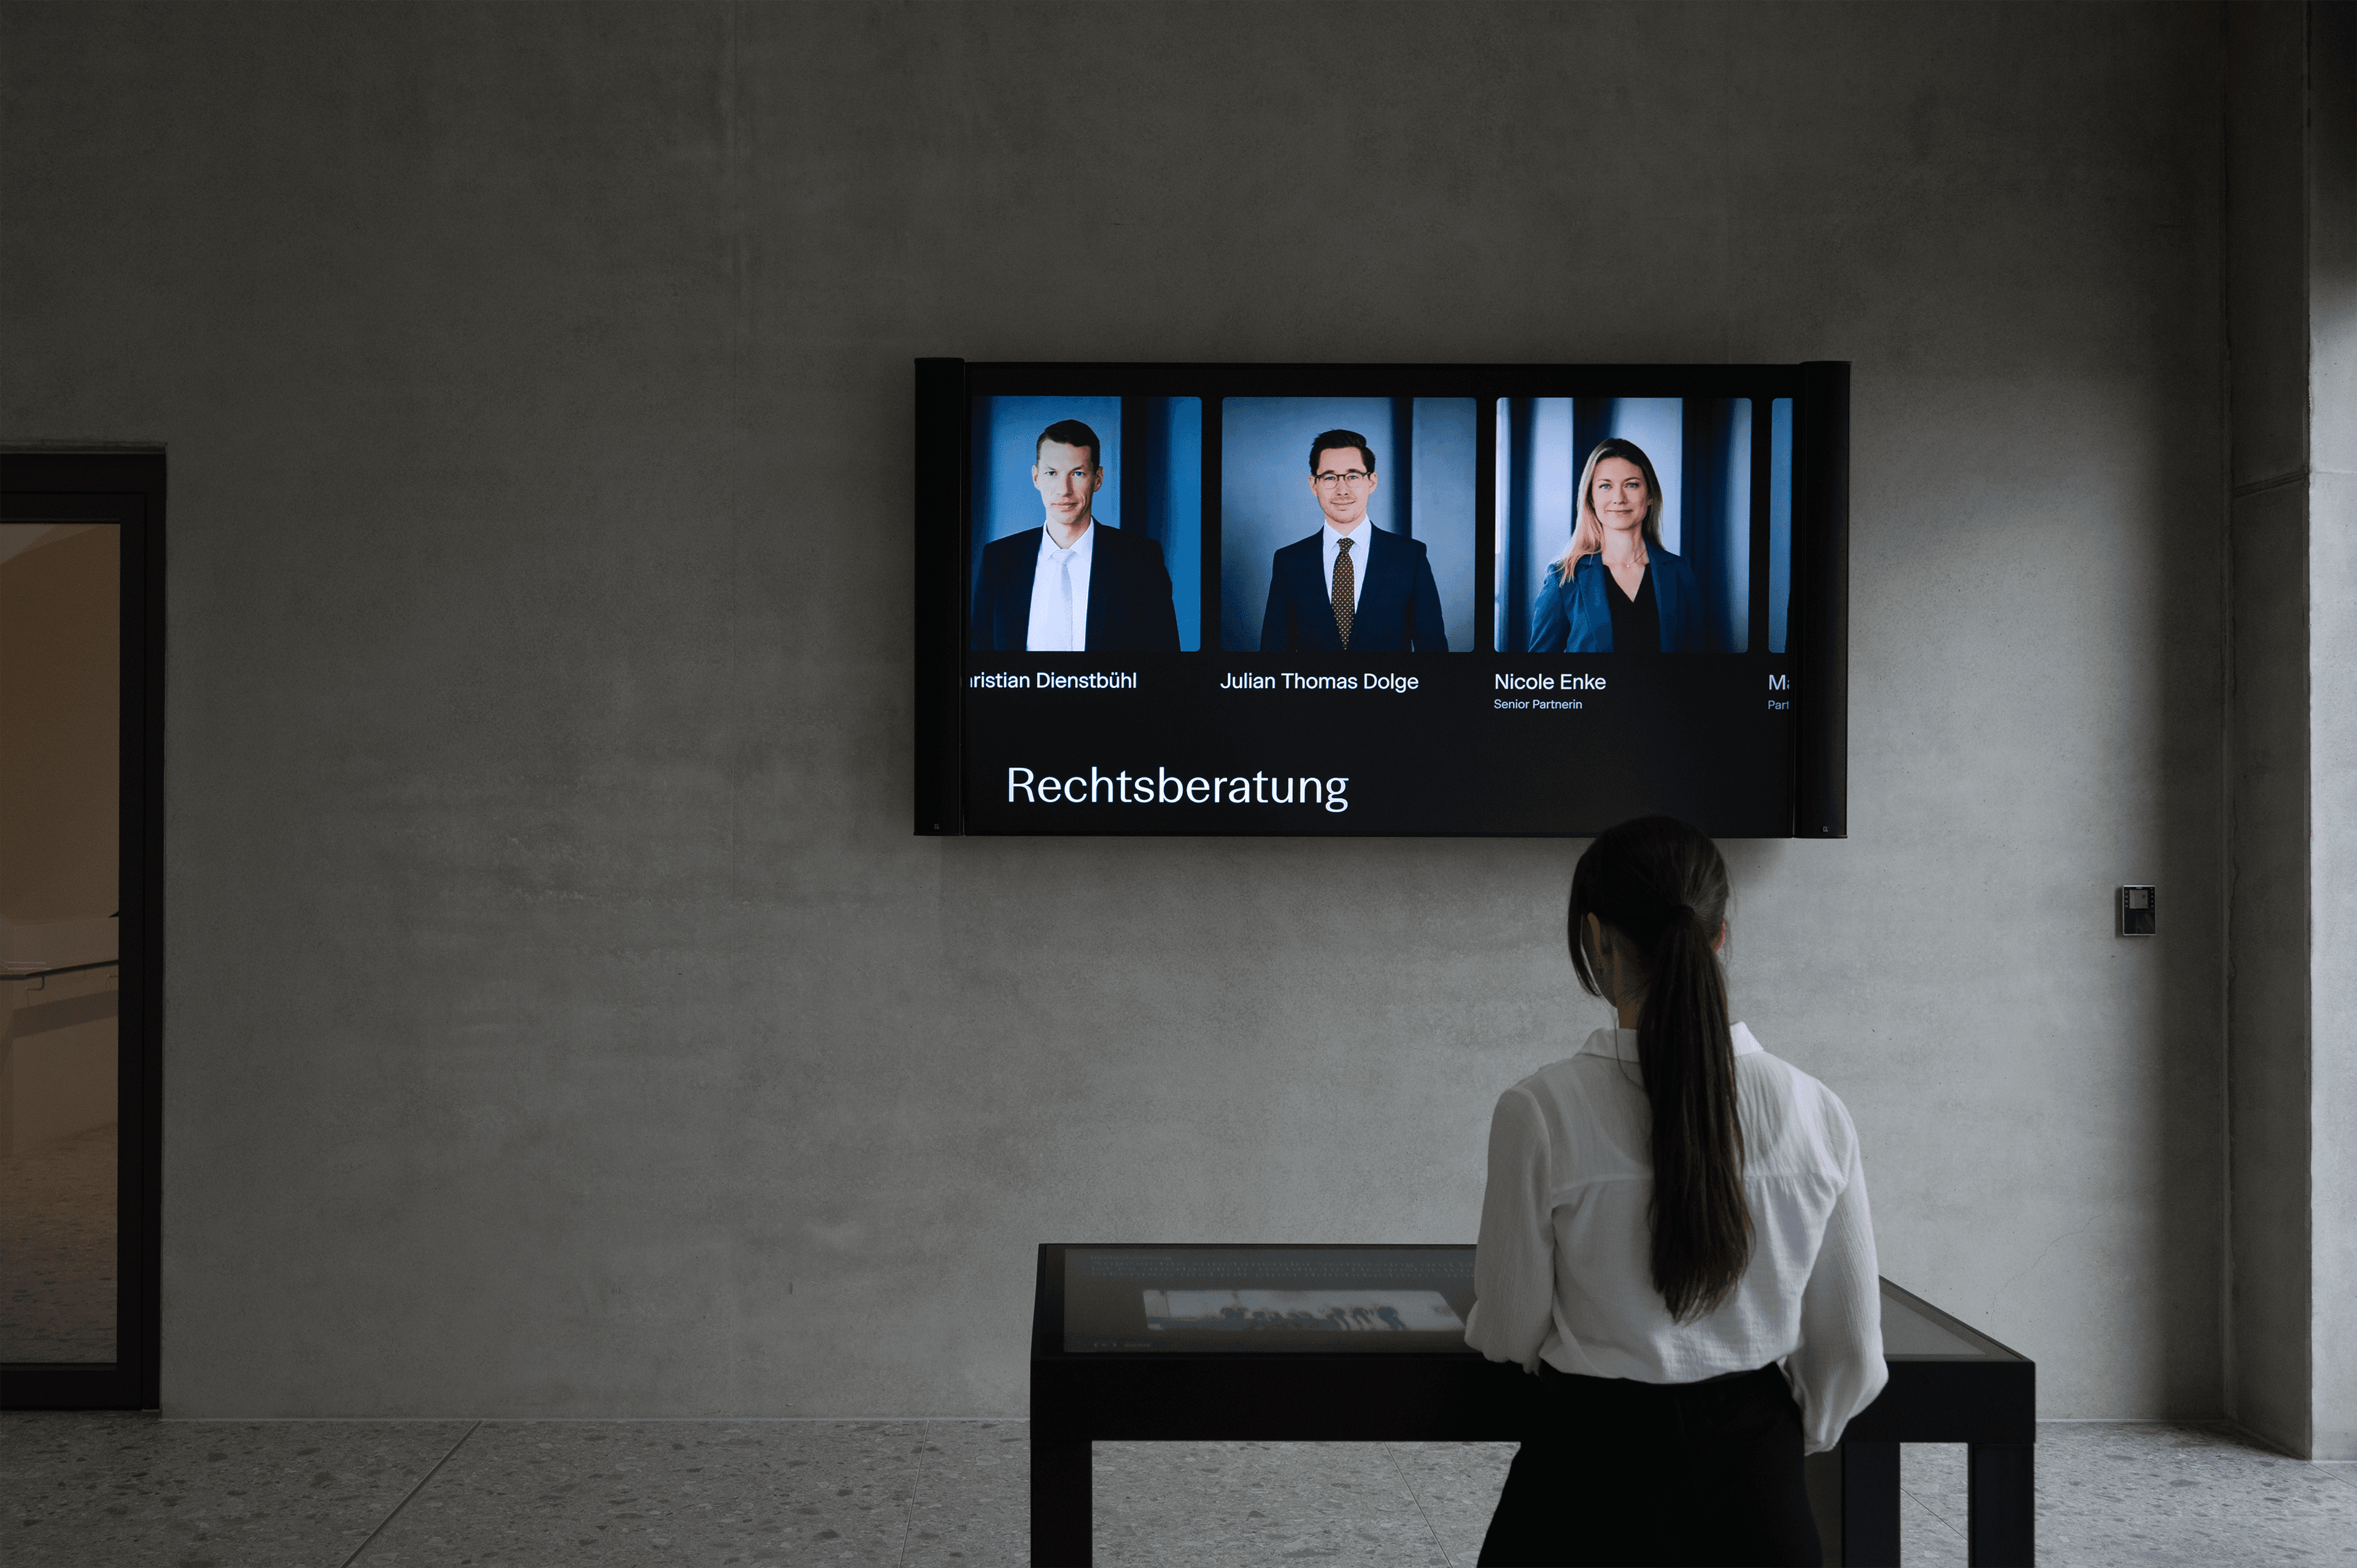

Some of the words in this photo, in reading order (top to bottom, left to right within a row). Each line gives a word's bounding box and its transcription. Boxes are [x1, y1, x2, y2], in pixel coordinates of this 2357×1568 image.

[970, 671, 1031, 689] ristian
[1036, 671, 1137, 689] Dienstbühl
[1220, 672, 1276, 689] Julian
[1280, 672, 1358, 690] Thomas
[1363, 673, 1419, 693] Dolge
[1495, 673, 1555, 690] Nicole
[1560, 673, 1607, 690] Enke
[1493, 698, 1530, 709] Senior
[1533, 698, 1583, 709] Partnerin
[1008, 766, 1350, 813] Rechtsberatung
